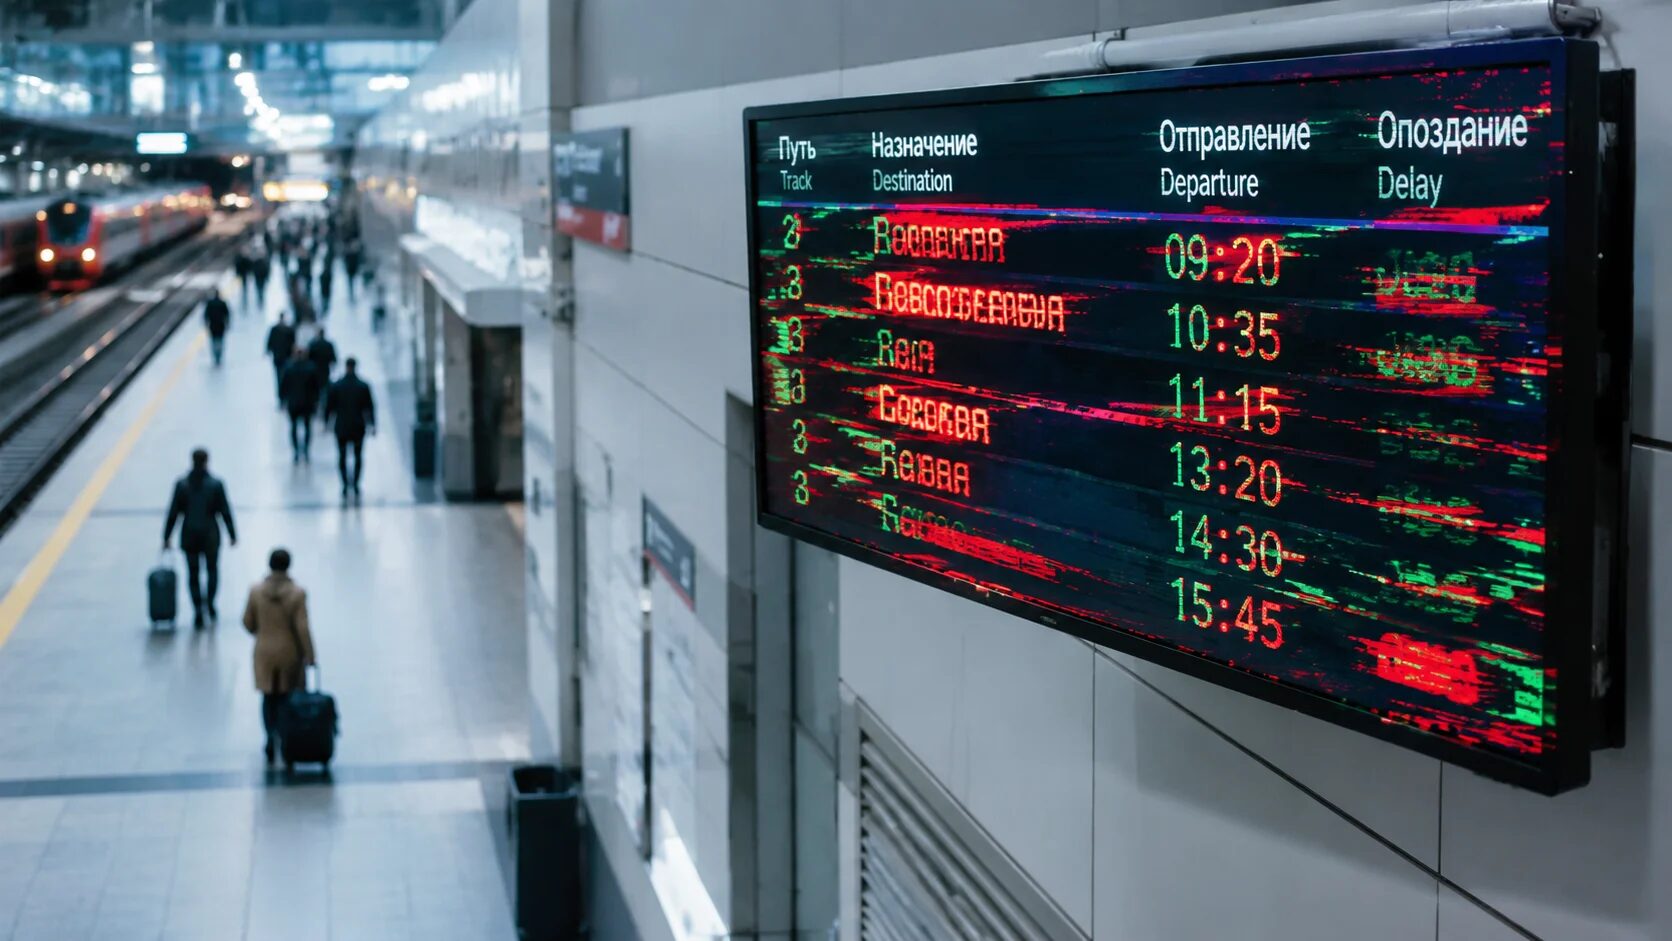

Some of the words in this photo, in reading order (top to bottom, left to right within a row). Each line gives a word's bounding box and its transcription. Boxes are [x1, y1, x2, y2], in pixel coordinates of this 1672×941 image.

[778, 135, 817, 166] Путь
[871, 131, 978, 158] Назначение
[1159, 119, 1311, 160] Отправление
[1378, 110, 1529, 155] Опоздание
[780, 170, 813, 191] Track
[872, 168, 953, 192] Destination
[1160, 167, 1260, 202] Departure
[1377, 166, 1443, 208] Delay
[1165, 233, 1280, 286] 09:20
[1167, 303, 1281, 361] 10:35
[1169, 373, 1281, 435] 11:15
[1170, 442, 1282, 507] 13:20
[1170, 510, 1282, 578] 14:30
[1171, 577, 1285, 649] 15:45
